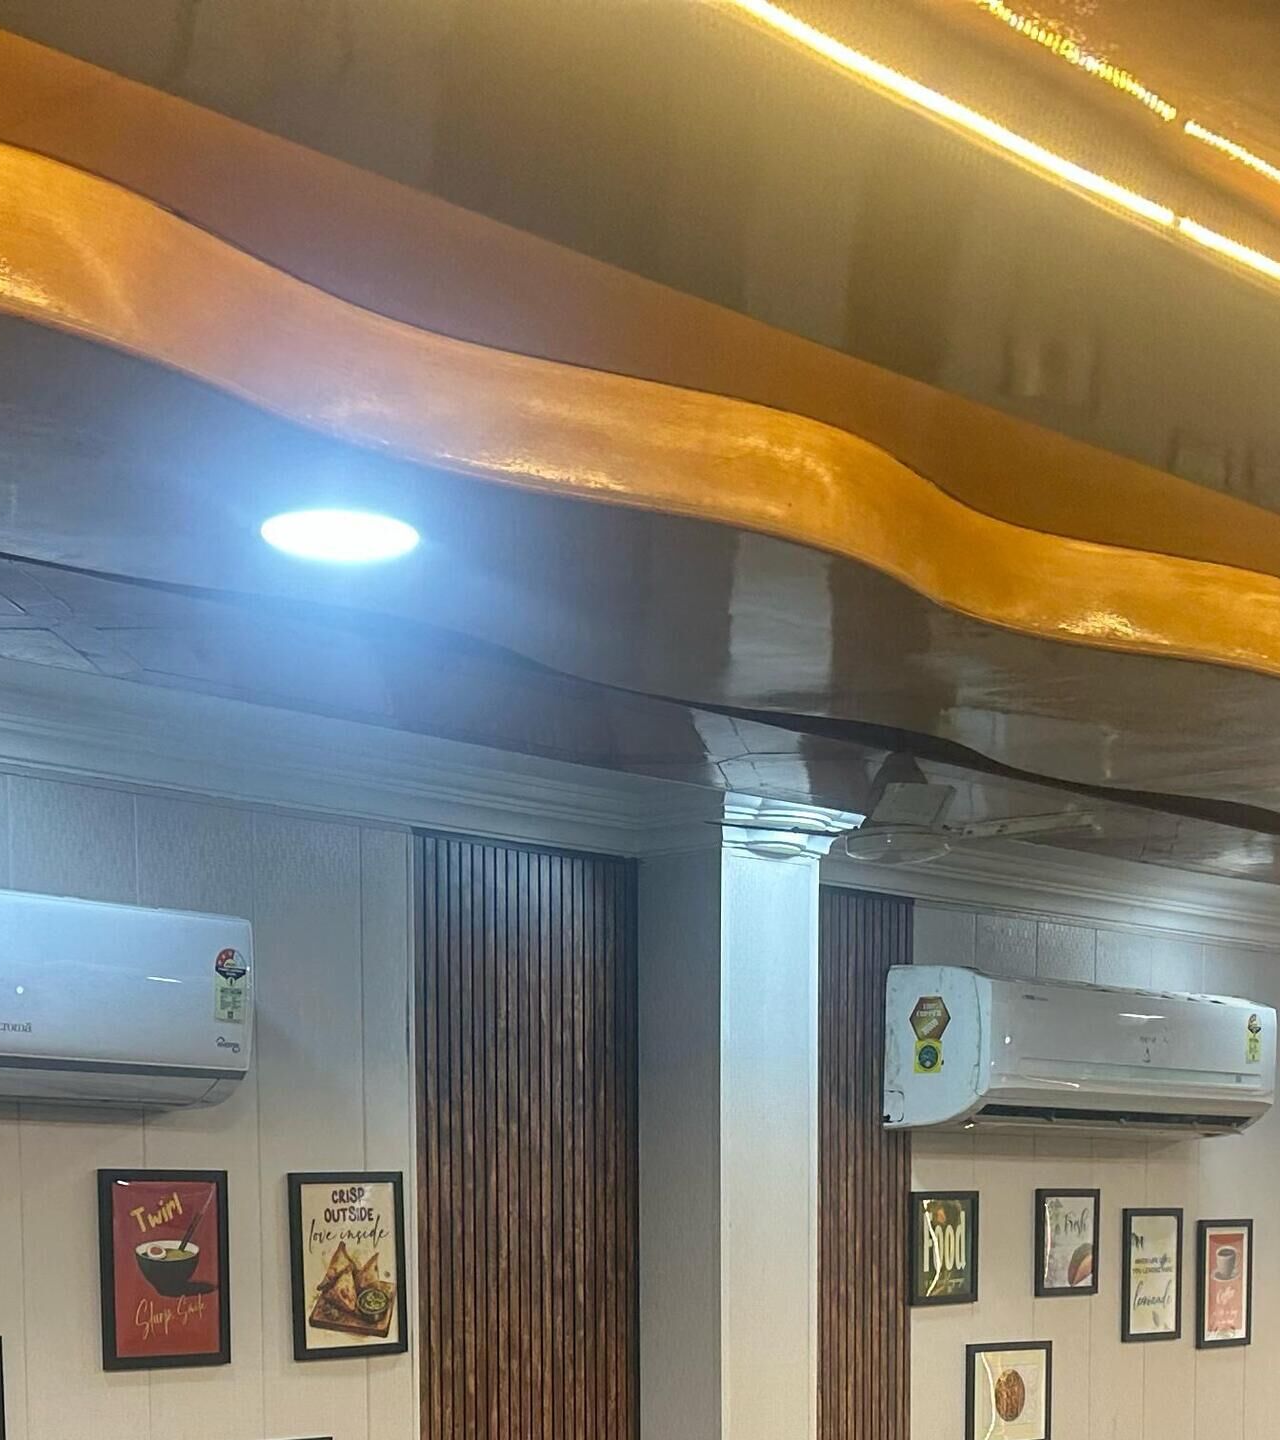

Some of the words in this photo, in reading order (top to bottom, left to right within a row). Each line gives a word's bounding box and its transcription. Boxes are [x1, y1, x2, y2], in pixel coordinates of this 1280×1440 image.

[130, 1192, 183, 1232] Twirl
[324, 1207, 374, 1223] OUTSIDE
[331, 1187, 365, 1204] CRISP
[309, 1219, 336, 1254] love
[340, 1215, 389, 1248] inside
[923, 1210, 966, 1273] Food
